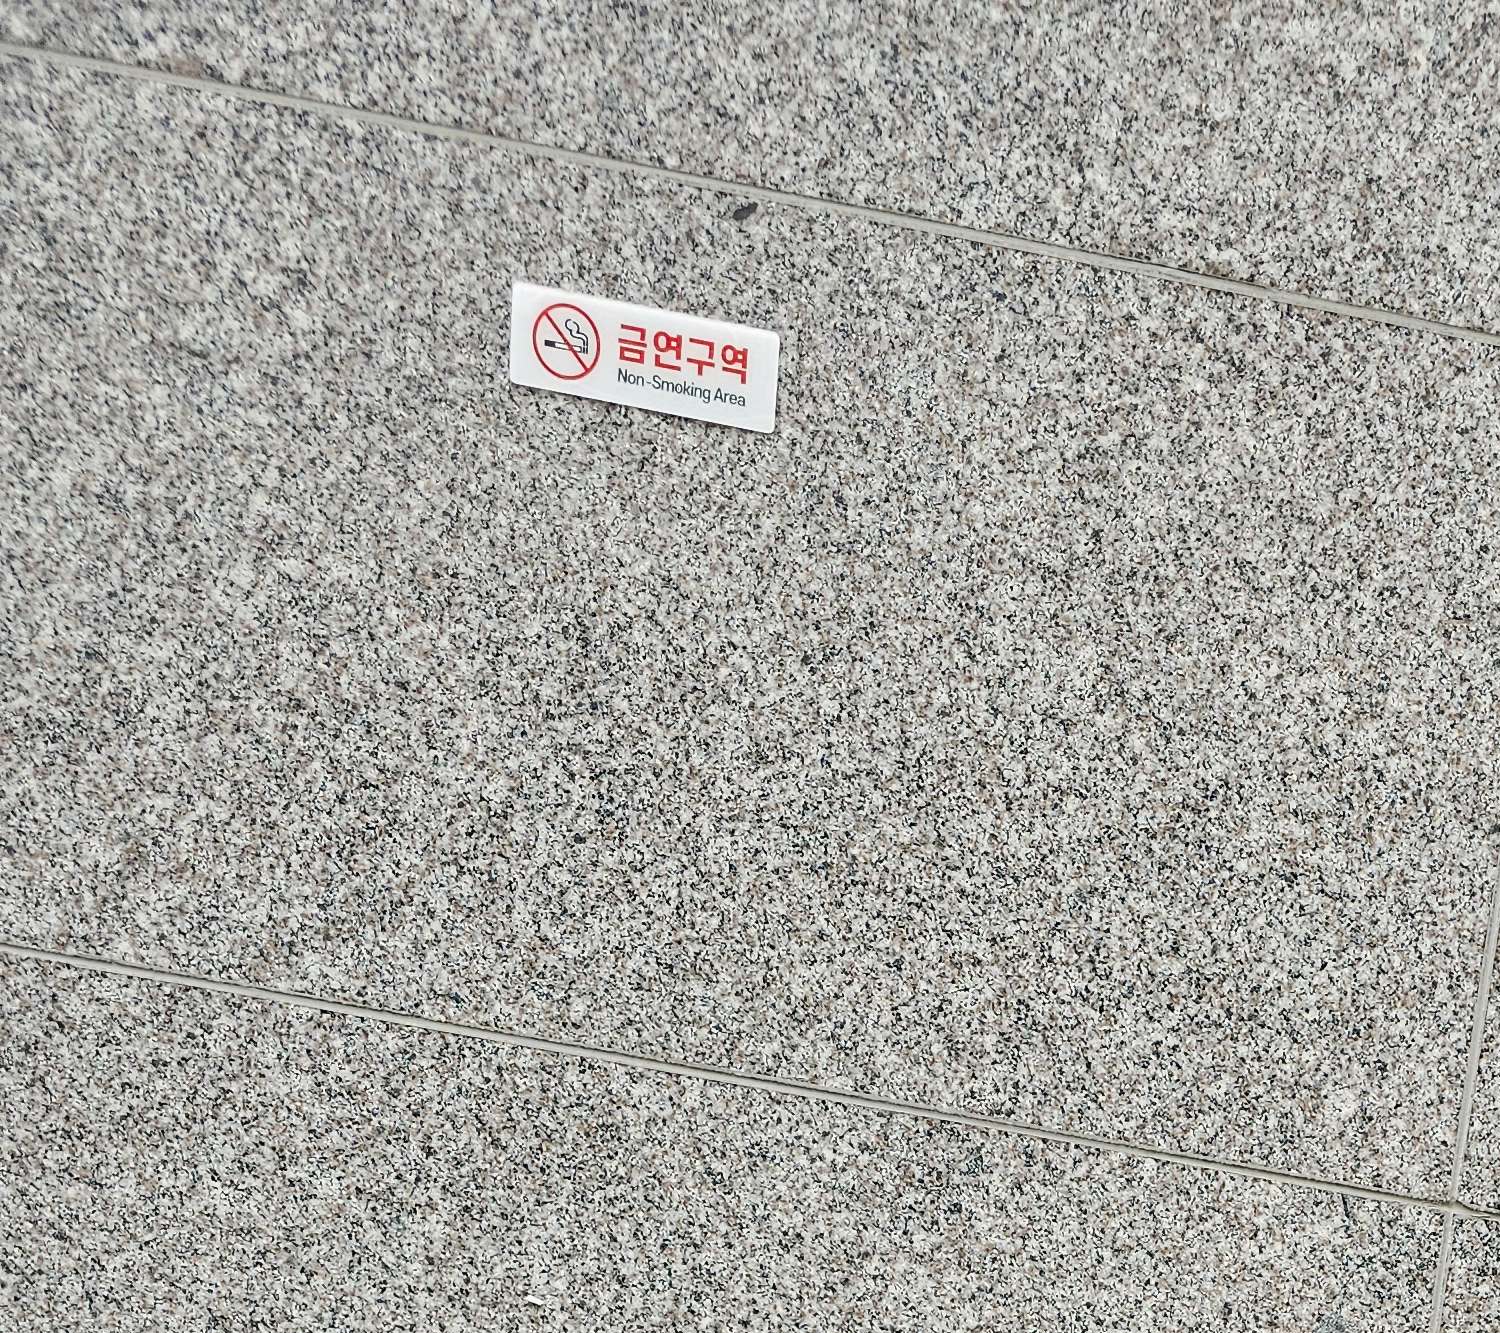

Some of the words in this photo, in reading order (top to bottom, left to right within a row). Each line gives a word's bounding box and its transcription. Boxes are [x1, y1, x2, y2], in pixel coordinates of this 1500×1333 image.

[617, 323, 749, 385] 금연구역
[617, 367, 711, 404] Non-Smoking
[713, 388, 746, 407] Area
